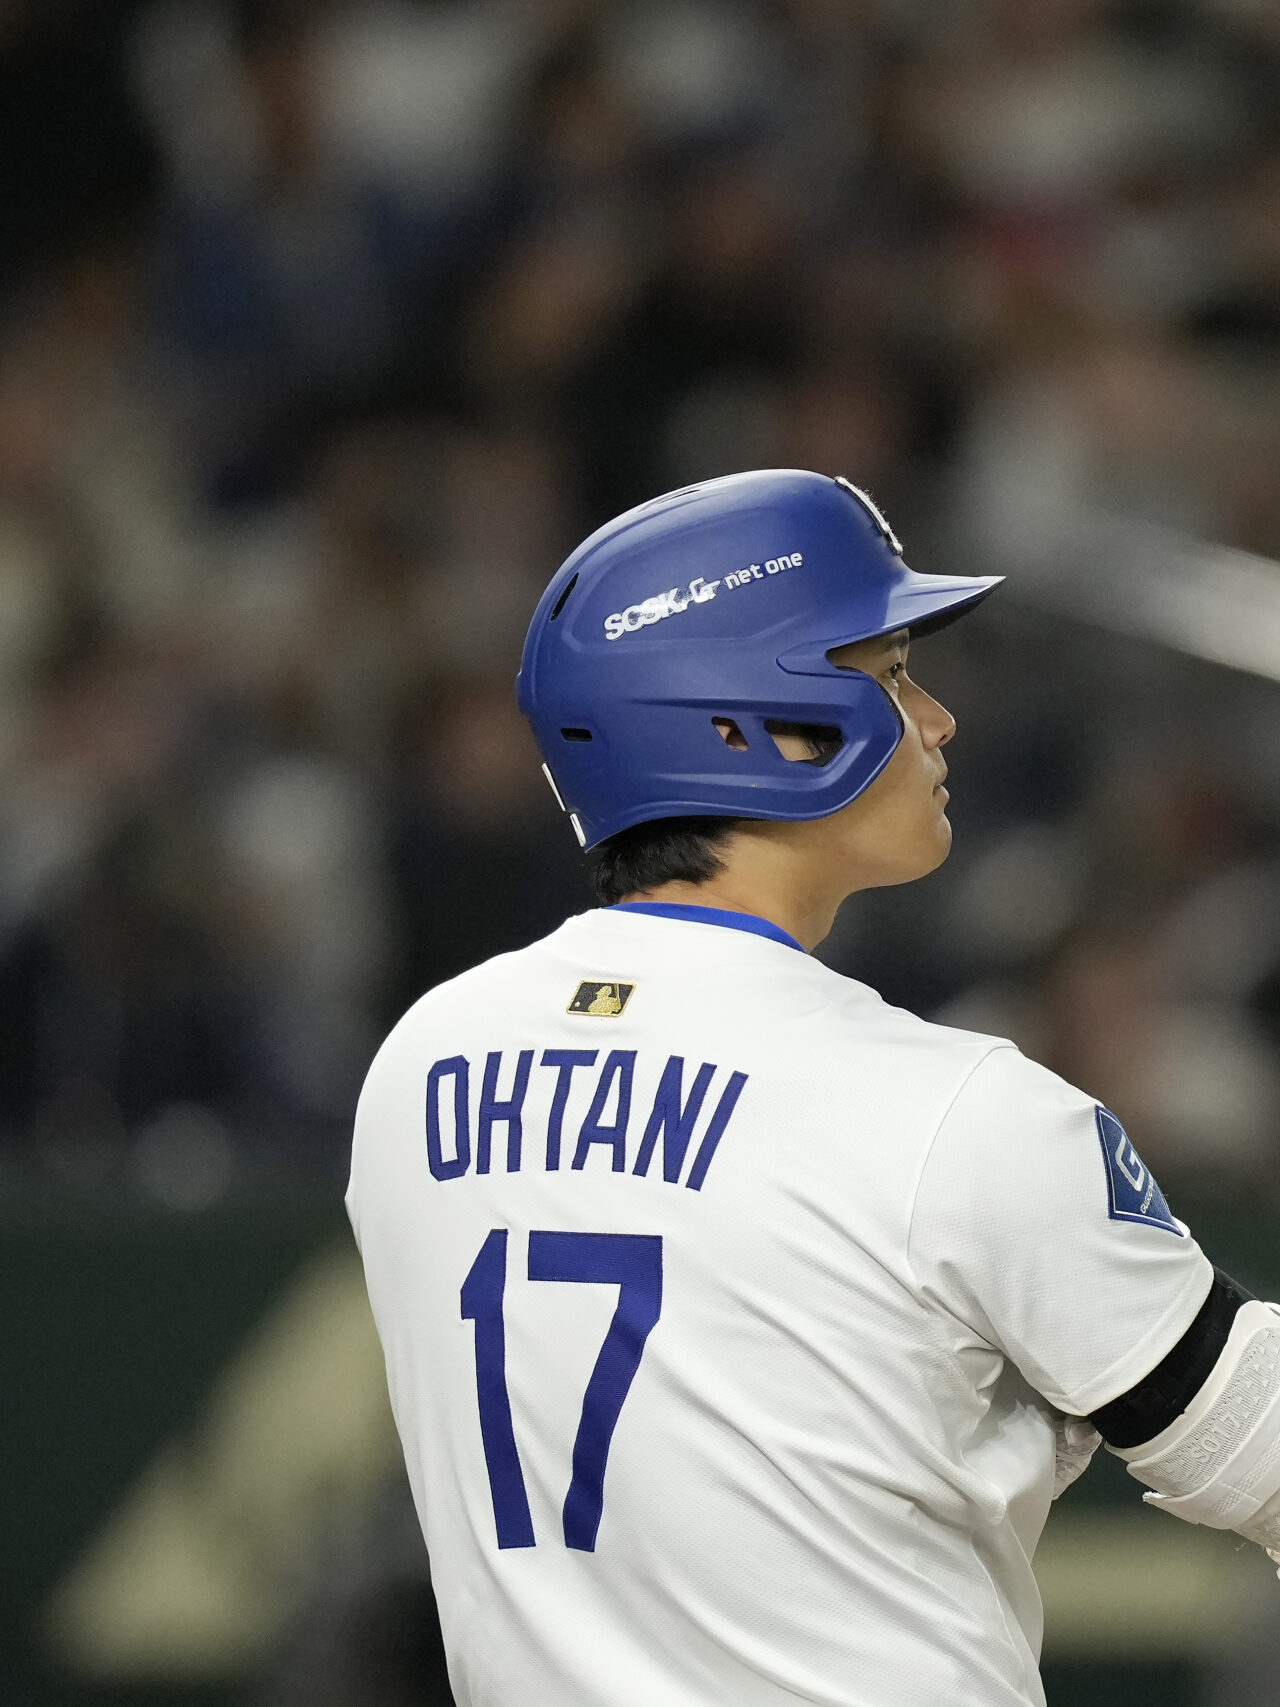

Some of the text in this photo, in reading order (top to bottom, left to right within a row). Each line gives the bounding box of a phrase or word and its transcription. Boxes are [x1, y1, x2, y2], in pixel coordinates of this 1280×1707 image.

[725, 564, 763, 589] net
[765, 552, 803, 575] one
[427, 1049, 749, 1191] OHTANI
[460, 1229, 663, 1552] 17
